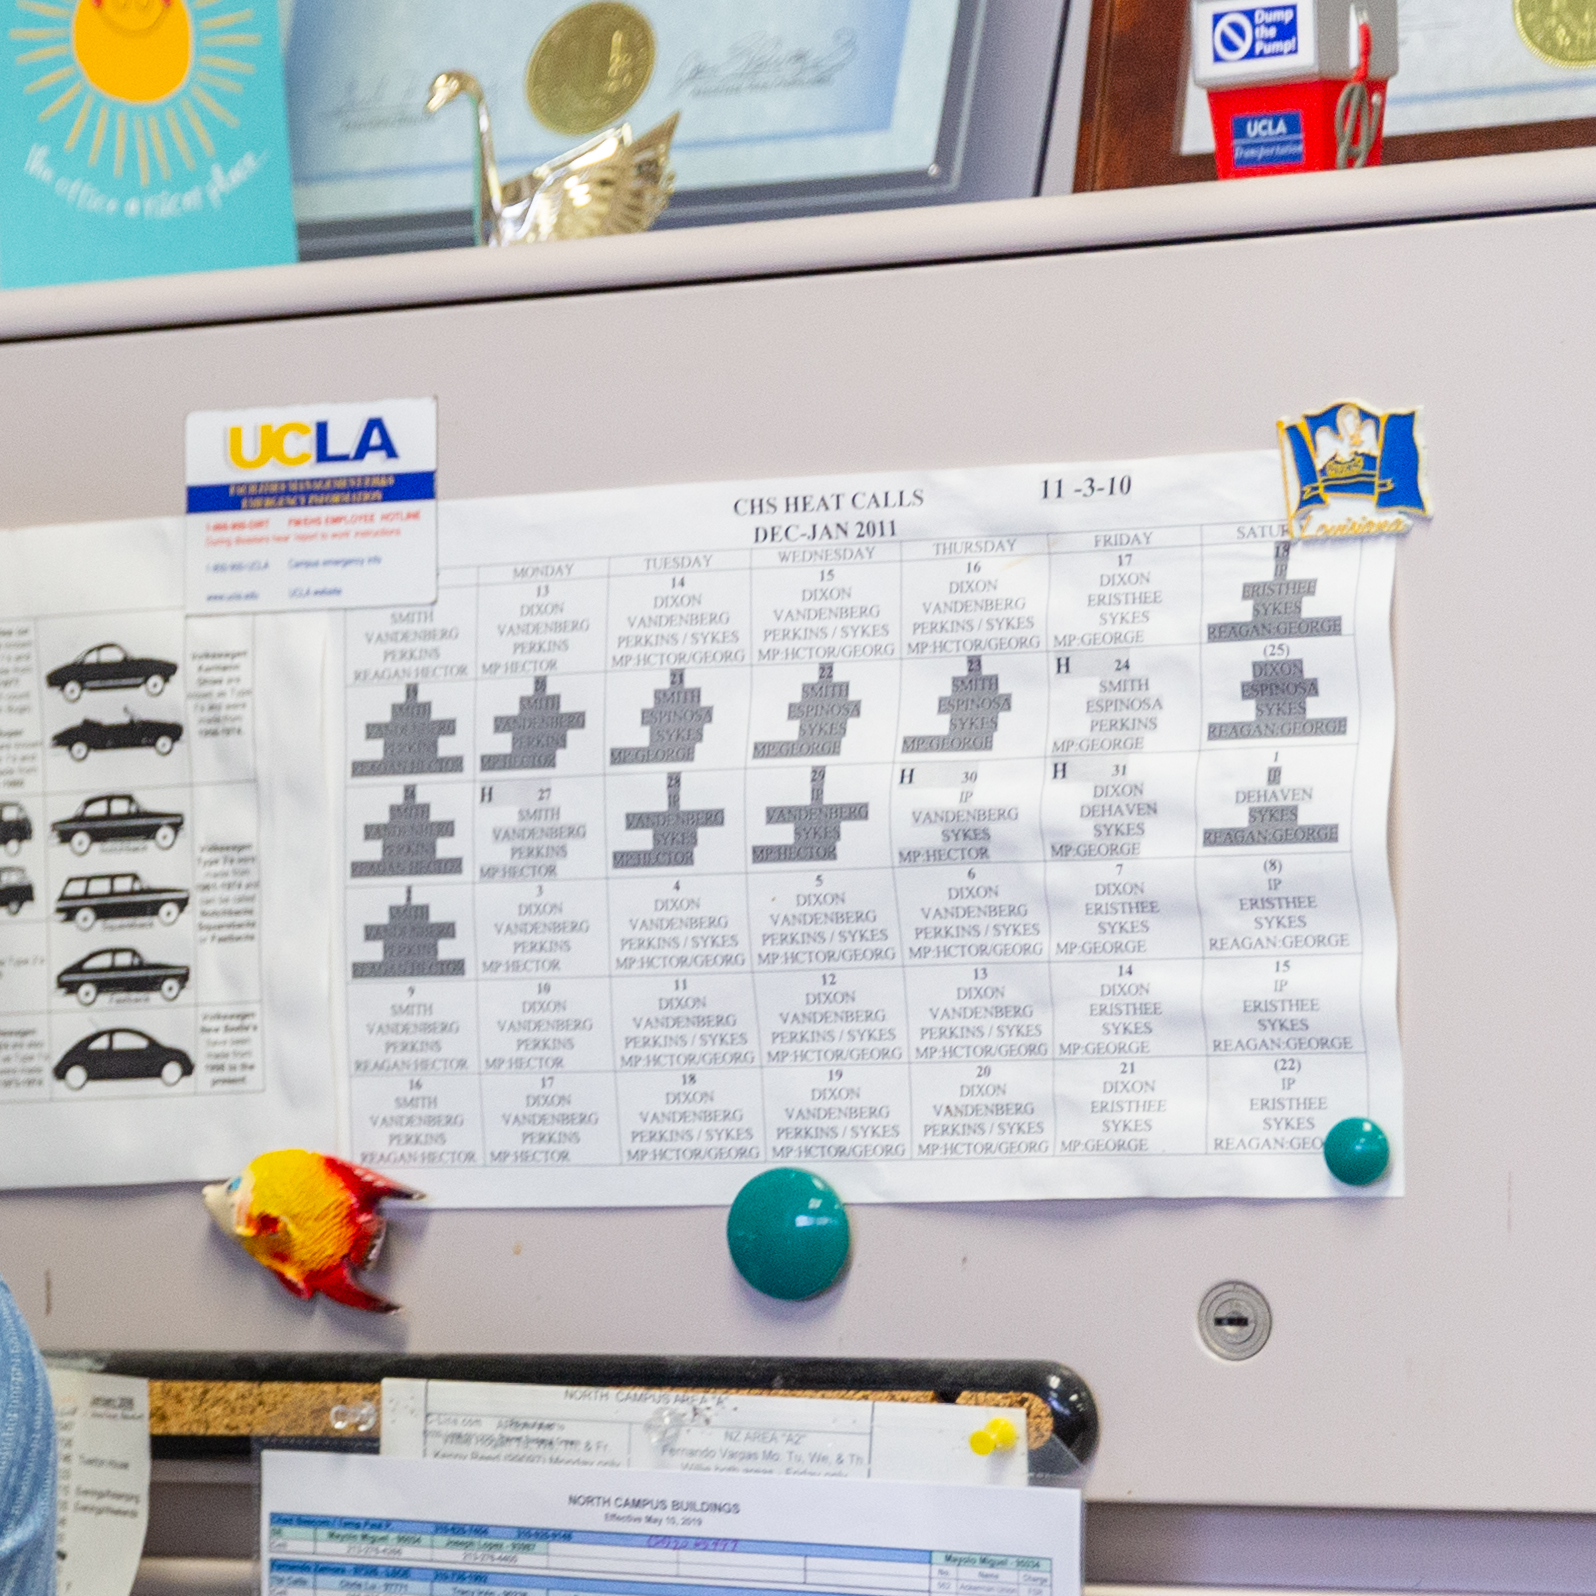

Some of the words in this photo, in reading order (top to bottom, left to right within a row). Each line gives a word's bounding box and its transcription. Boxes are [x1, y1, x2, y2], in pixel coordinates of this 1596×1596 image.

[1255, 9, 1294, 24] Dump
[1255, 26, 1277, 38] the
[1255, 37, 1296, 55] Pump!
[1247, 118, 1287, 137] UCLA
[229, 417, 399, 469] UCLA
[1040, 479, 1065, 499] 11
[1072, 475, 1132, 498] -3-10
[733, 498, 780, 516] CHS
[785, 494, 844, 513] HEAT
[851, 490, 925, 512] CALLS
[753, 524, 849, 544] DEC-JAN
[854, 520, 897, 539] 2011
[1236, 525, 1289, 540] SATUR
[1301, 515, 1405, 538] Louisiana
[933, 538, 1017, 556] THURSDAY
[1093, 531, 1153, 548] FRIDAY
[644, 554, 713, 571] TUESDAY
[778, 547, 876, 564] WEDNESDAY
[1118, 553, 1132, 567] 17
[512, 564, 574, 580] MONDAY
[819, 568, 834, 582] 15
[966, 560, 982, 574] 16
[948, 579, 999, 594] DIXON
[1099, 571, 1151, 587] DIXON
[801, 586, 852, 603] DIXON
[1087, 591, 1163, 607] ERISTHEE
[773, 604, 880, 623] VANDENBERG
[922, 597, 1026, 614] VANDENBERG
[912, 618, 978, 634] PERKINS
[987, 616, 1035, 631] SYKES
[1099, 610, 1150, 625] SYKES
[762, 625, 827, 642] PERKINS
[842, 623, 889, 639] SYKES
[1263, 642, 1290, 659] (25)
[1056, 657, 1071, 674] H
[1114, 657, 1131, 672] 24
[1099, 678, 1150, 694] SMITH
[1086, 697, 1164, 714] ESPINOSA
[1090, 716, 1158, 733] PERKINS
[1273, 751, 1279, 762] 1
[900, 768, 915, 784] H
[961, 770, 978, 784] 30
[1052, 762, 1067, 779] H
[1111, 763, 1128, 777] 31
[959, 789, 973, 804] IP
[1092, 782, 1144, 799] DIXON
[1235, 786, 1313, 804] DEHAVEN
[912, 806, 1019, 824] VANDENBERG
[1079, 802, 1158, 819] DEHAVEN
[1093, 822, 1145, 838] SYKES
[967, 868, 976, 880] 6
[1115, 863, 1123, 877] 7
[1263, 858, 1283, 875] (8)
[815, 875, 824, 888] 5
[1095, 881, 1145, 897] DIXON
[1267, 877, 1282, 892] IP
[796, 891, 846, 908] DIXON
[948, 885, 999, 900] DIXON
[1084, 900, 1160, 917] ERISTHEE
[1239, 894, 1317, 913] ERISTHEE
[769, 909, 877, 927] VANDENBERG
[921, 903, 1028, 921] VANDENBERG
[1098, 920, 1150, 935] SYKES
[1254, 914, 1307, 930] SYKES
[914, 924, 980, 940] PERKINS
[992, 922, 1040, 938] SYKES
[973, 968, 988, 981] 13
[1117, 964, 1134, 978] 14
[1274, 960, 1291, 974] 15
[956, 985, 1006, 1001] DIXON
[1100, 982, 1151, 998] DIXON
[1273, 978, 1289, 993] IP
[929, 1004, 1034, 1022] VANDENBERG
[1089, 1001, 1163, 1018] ERISTHEE
[1242, 997, 1321, 1014] ERISTHEE
[1101, 1020, 1153, 1036] SYKES
[1257, 1017, 1309, 1033] SYKES
[975, 1065, 992, 1079] 20
[1119, 1061, 1136, 1075] 21
[1273, 1058, 1302, 1074] (22)
[959, 1082, 1007, 1098] DIXON
[1102, 1079, 1156, 1095] DIXON
[1281, 1076, 1296, 1092] IP
[1090, 1098, 1167, 1115] ERISTHEE
[1249, 1096, 1328, 1113] ERISTHEE
[1101, 1118, 1153, 1133] SYKES
[1262, 1116, 1316, 1132] SYKES
[1213, 1135, 1324, 1153] REAGAN:GEO
[615, 1391, 669, 1404] CAMPUS
[744, 1432, 778, 1443] AREA
[569, 1494, 611, 1508] NORTH
[614, 1498, 667, 1511] CAMPUS
[671, 1501, 740, 1513] BUILDINGS
